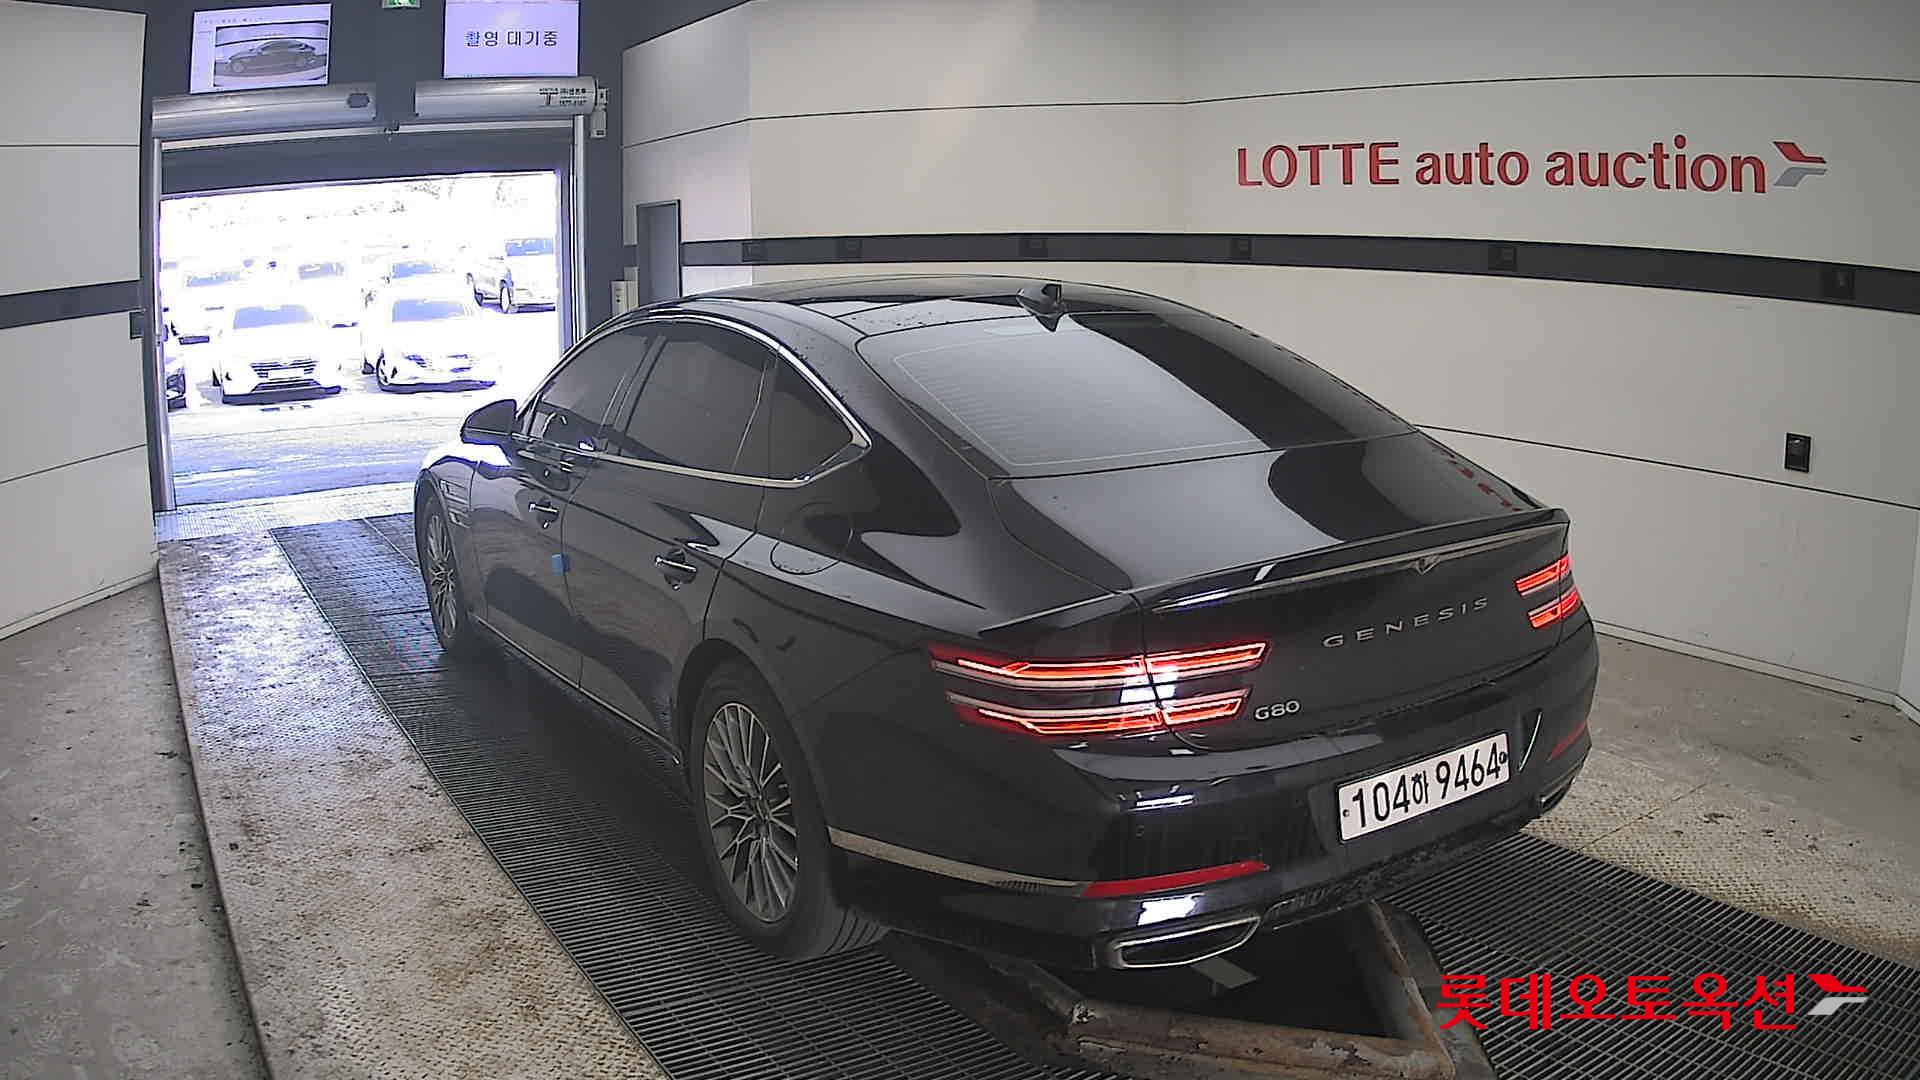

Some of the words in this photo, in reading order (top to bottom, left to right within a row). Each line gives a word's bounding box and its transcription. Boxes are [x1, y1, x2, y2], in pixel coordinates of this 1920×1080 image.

[507, 31, 558, 47] 대기중
[1237, 141, 1400, 189] LOTTE
[1415, 142, 1530, 187] auto
[1544, 134, 1767, 194] auction
[1323, 597, 1488, 648] GENESIS
[1255, 700, 1300, 720] G80
[1352, 770, 1429, 828] 104하
[1436, 742, 1501, 800] 9464
